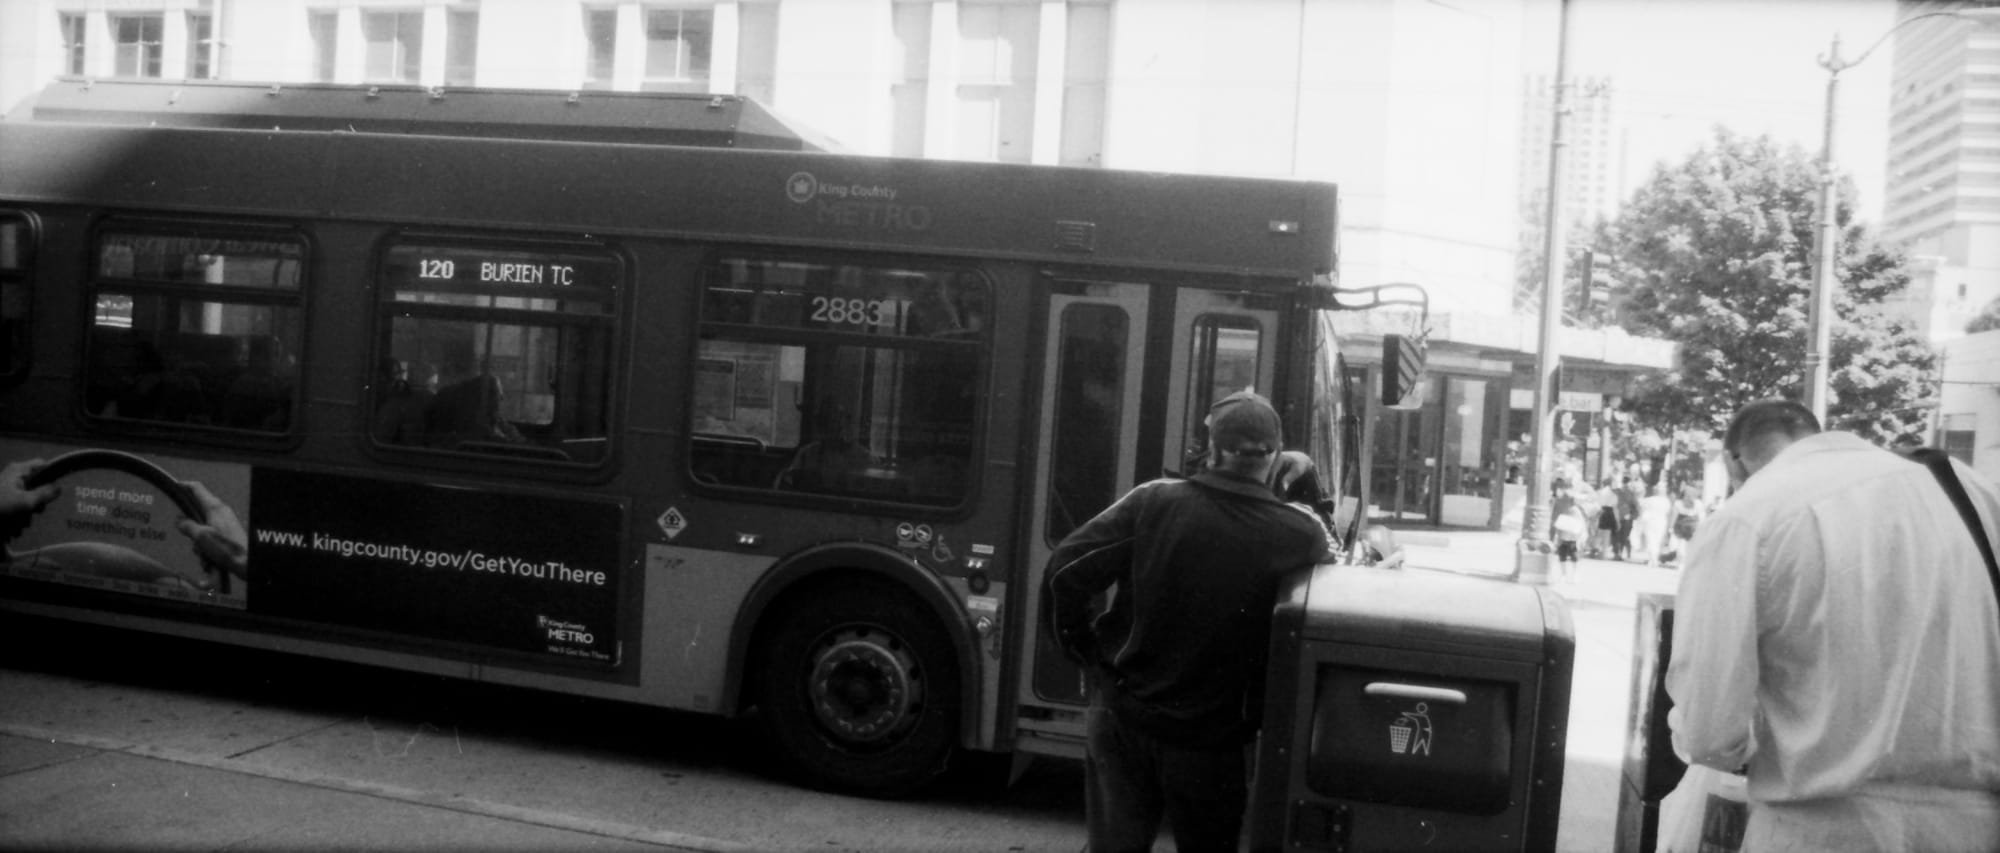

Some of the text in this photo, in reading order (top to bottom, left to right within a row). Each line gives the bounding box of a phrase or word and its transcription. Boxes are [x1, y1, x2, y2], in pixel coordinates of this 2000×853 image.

[818, 182, 897, 202] King County
[816, 200, 932, 230] METRO
[419, 259, 574, 286] 120 BURIEN TC
[811, 296, 882, 326] 2883
[74, 485, 154, 505] spend more
[76, 501, 151, 524] time doing
[66, 518, 167, 541] something else
[256, 529, 606, 586] www. kingcounty.gov/GetYouThere
[548, 628, 594, 645] METRO
